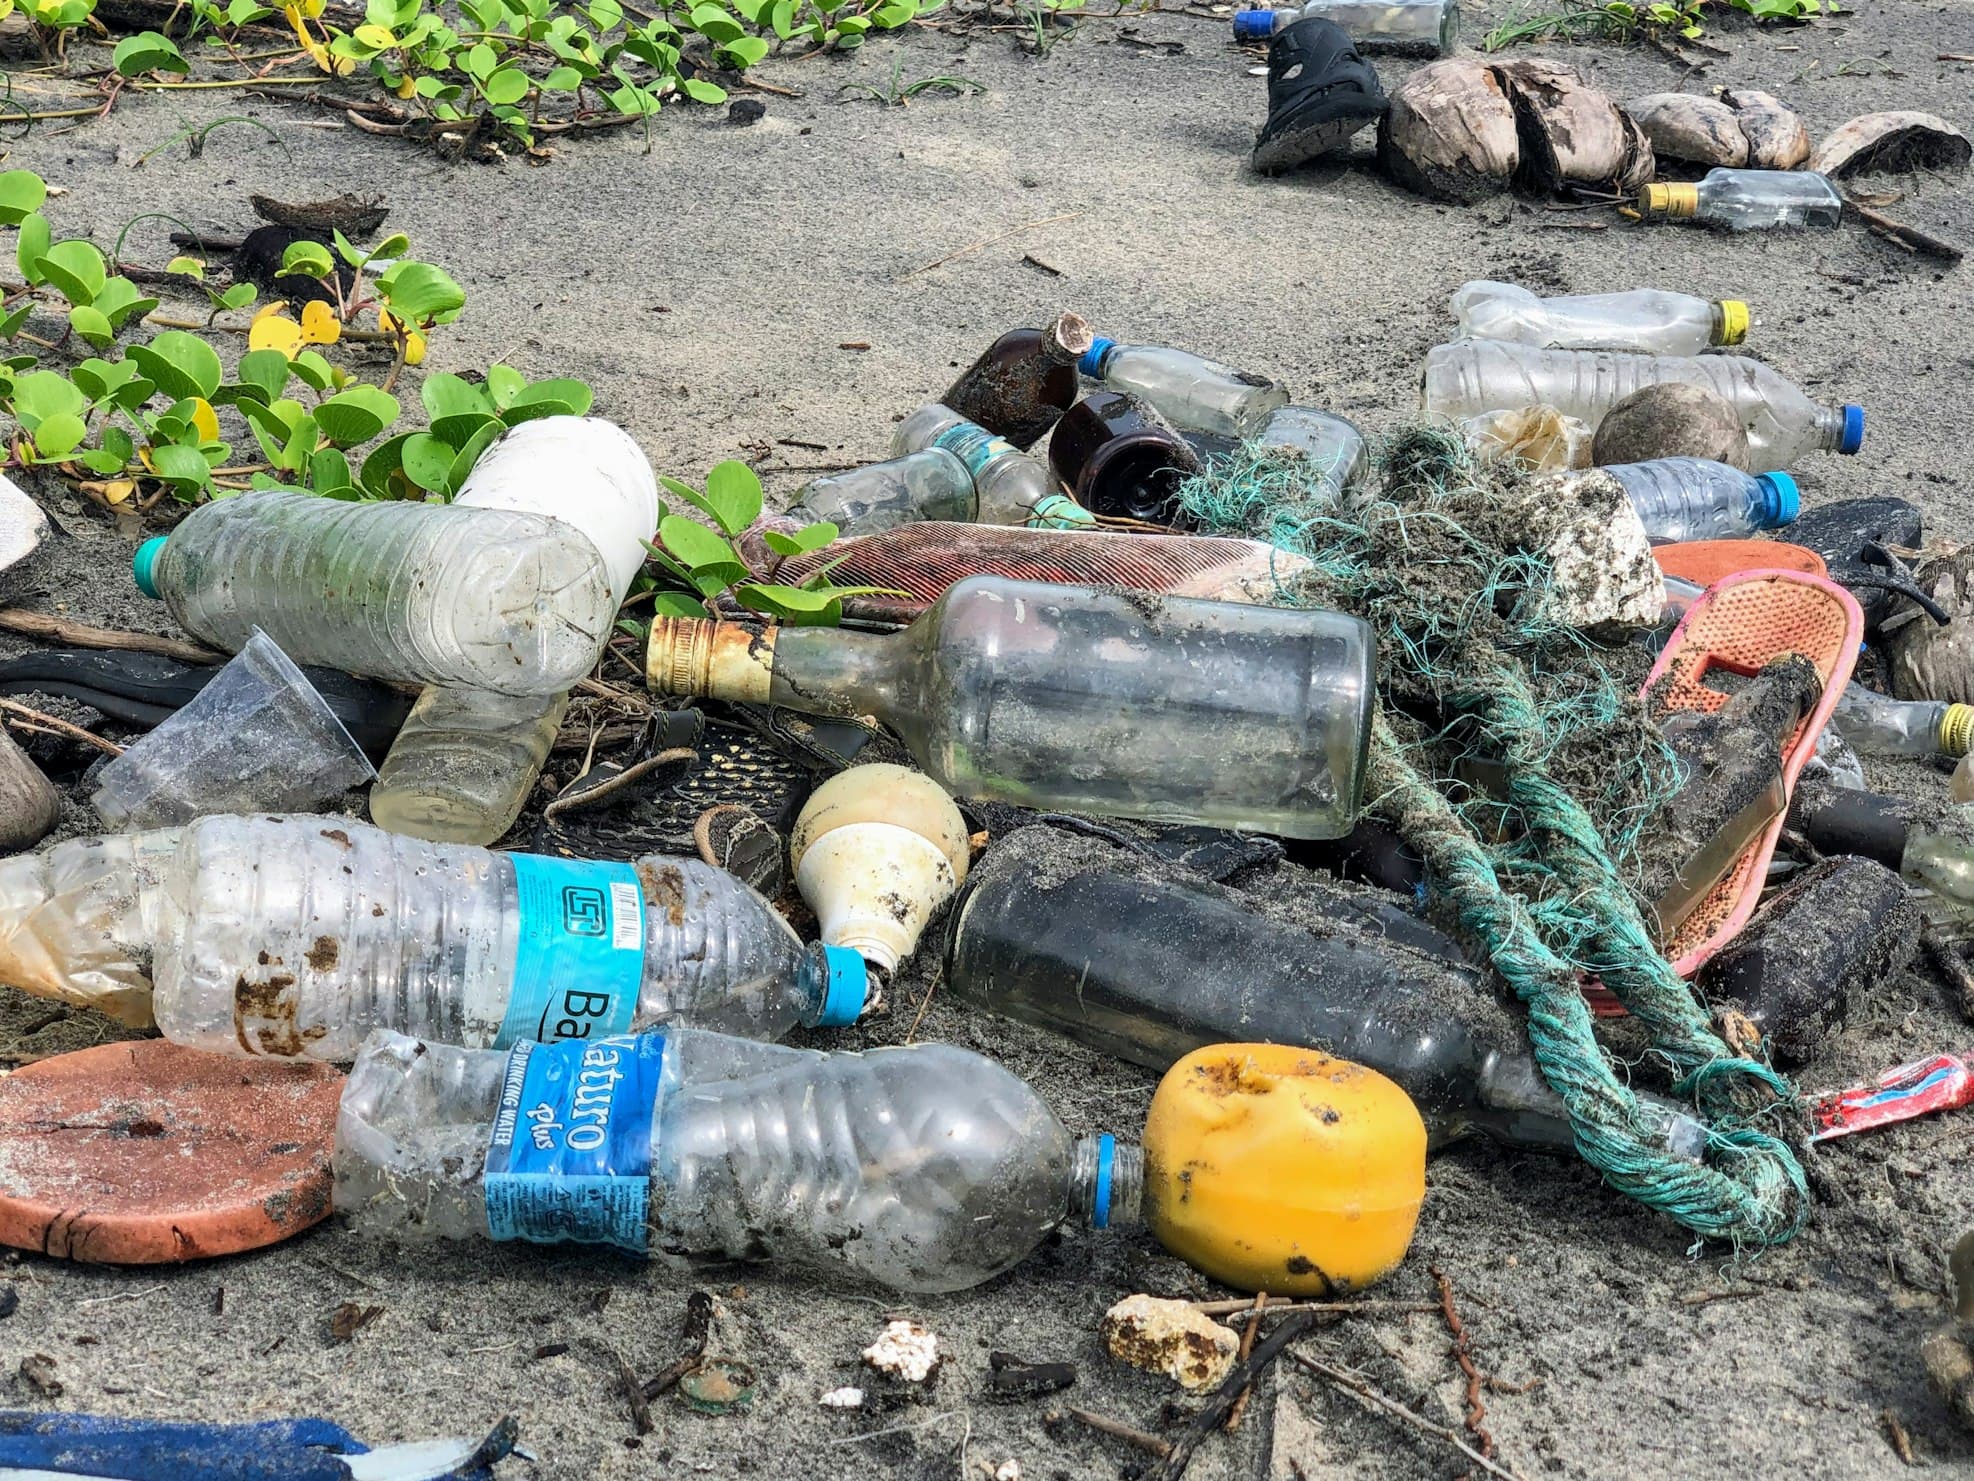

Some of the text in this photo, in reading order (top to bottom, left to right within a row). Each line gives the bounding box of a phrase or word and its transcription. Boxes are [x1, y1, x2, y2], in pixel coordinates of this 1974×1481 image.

[551, 989, 610, 1043] Ba
[502, 1053, 527, 1107] DRINKING
[494, 1108, 515, 1146] WATER
